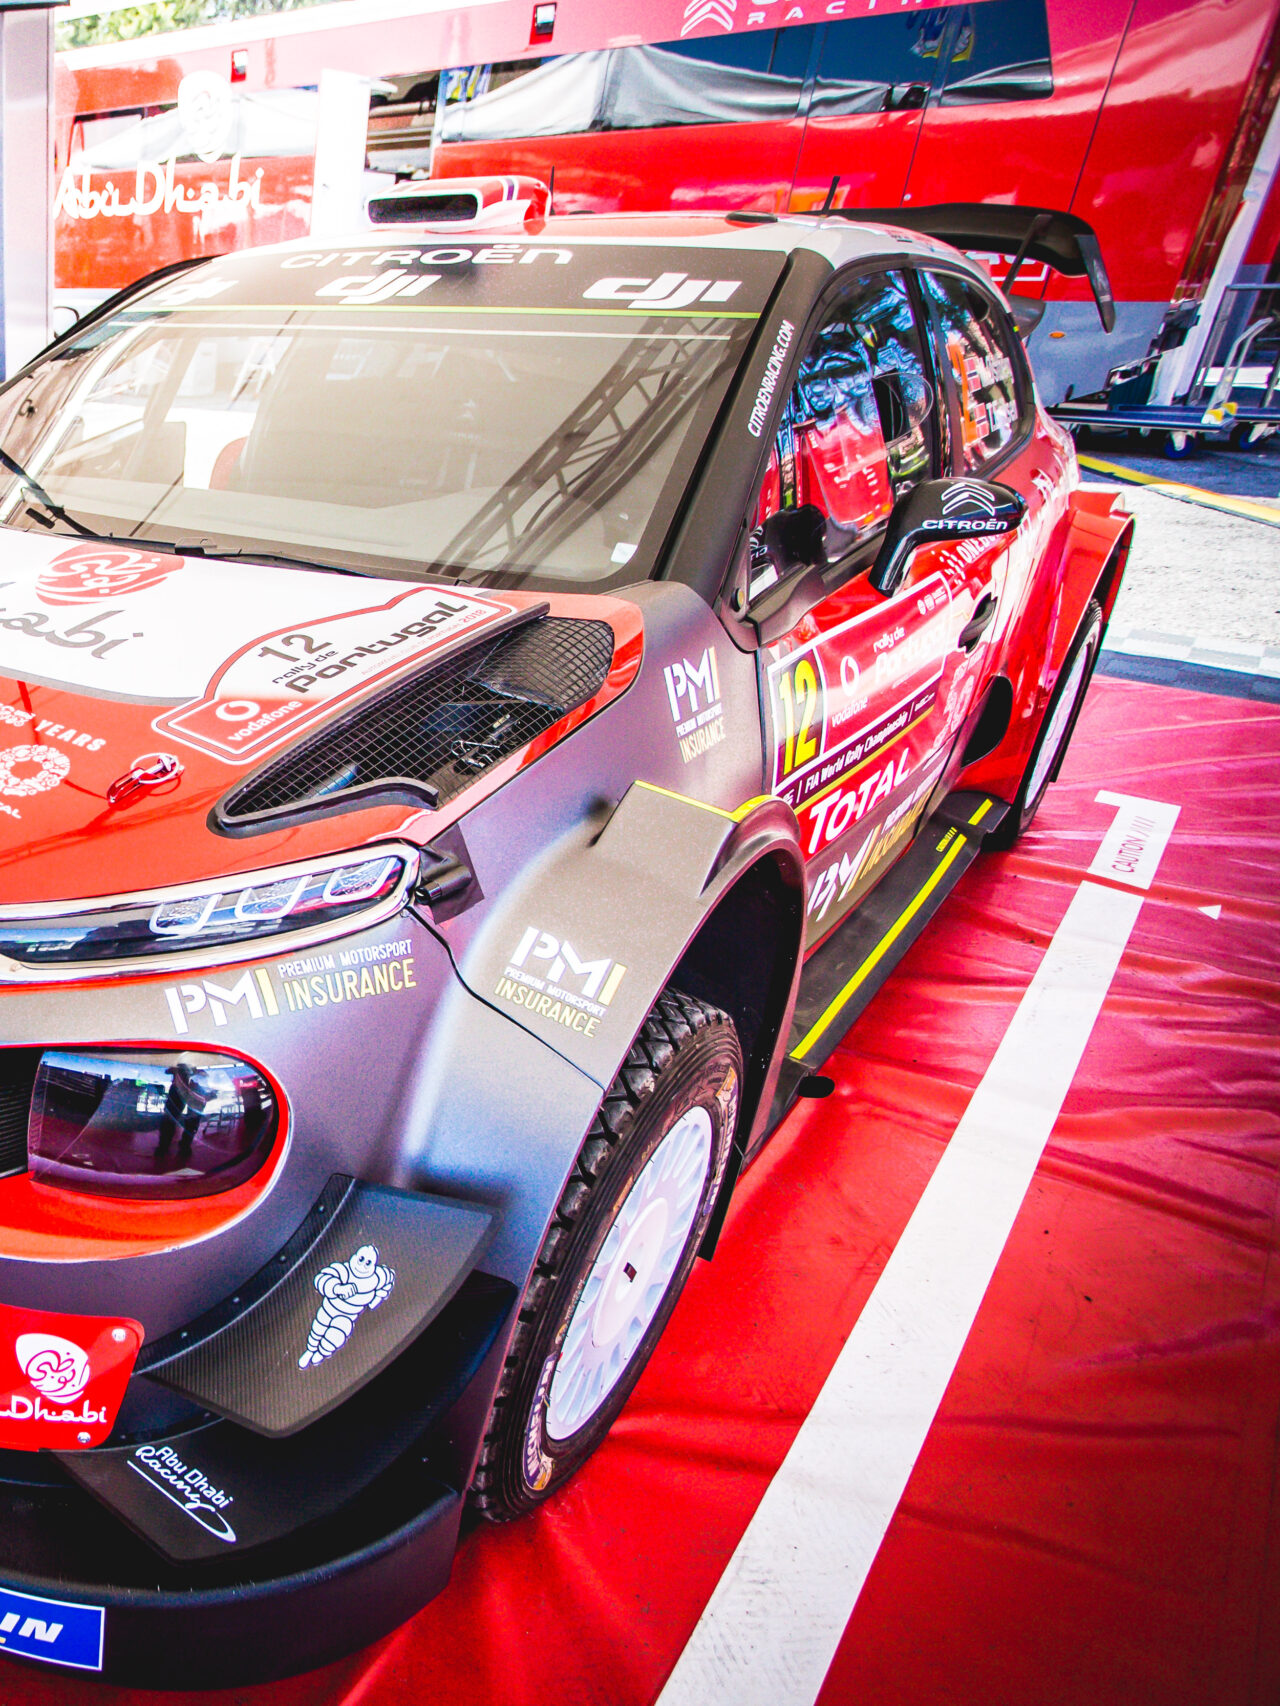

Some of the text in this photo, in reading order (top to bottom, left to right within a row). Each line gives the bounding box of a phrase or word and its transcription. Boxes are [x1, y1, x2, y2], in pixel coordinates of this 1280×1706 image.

[746, 319, 796, 438] CITROENRACING.COM
[457, 608, 487, 625] 2018
[873, 625, 906, 653] rally de
[257, 634, 332, 664] 12
[271, 650, 339, 685] rally de
[663, 645, 721, 722] PMI
[34, 719, 107, 752] YEARS
[227, 699, 302, 743] vodafone
[778, 659, 818, 776] 12
[831, 697, 869, 728] vodafone
[679, 716, 727, 764] INSURANCE
[804, 776, 820, 794] FIA
[820, 753, 845, 783] World
[807, 746, 911, 855] TOTAL
[1111, 833, 1147, 874] CAUTION
[277, 938, 413, 979] PREMIUM MOTORSPORT
[508, 926, 628, 1007] PMI
[164, 967, 280, 1035] PMI
[282, 957, 417, 1013] INSURANCE
[494, 977, 602, 1039] INSURANCE
[503, 966, 608, 1018] PREMIUM MOTORSPORT
[135, 1445, 216, 1513] Racing
[155, 1445, 234, 1509] Abu Dhabi
